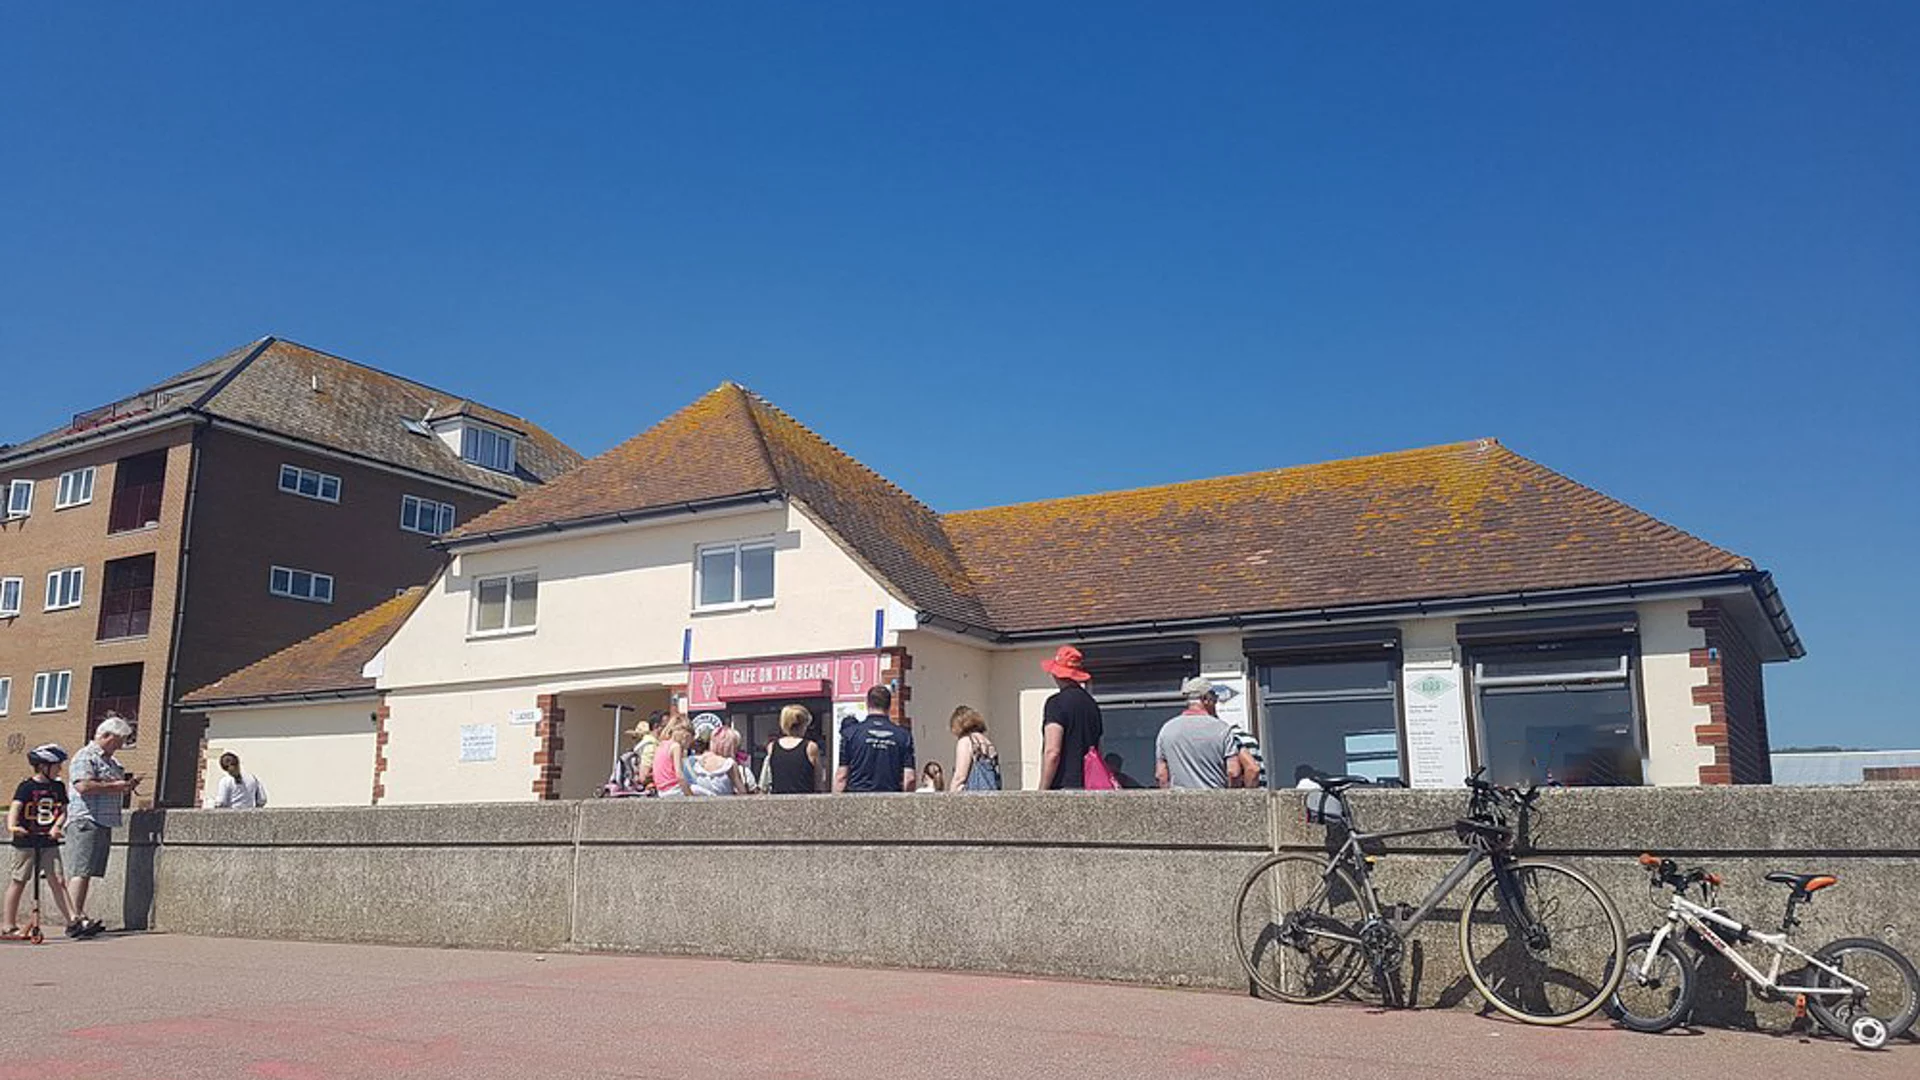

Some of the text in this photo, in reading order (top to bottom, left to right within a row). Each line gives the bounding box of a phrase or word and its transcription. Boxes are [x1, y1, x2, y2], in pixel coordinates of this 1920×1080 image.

[732, 662, 829, 685] CAFE ON THE BEACH
